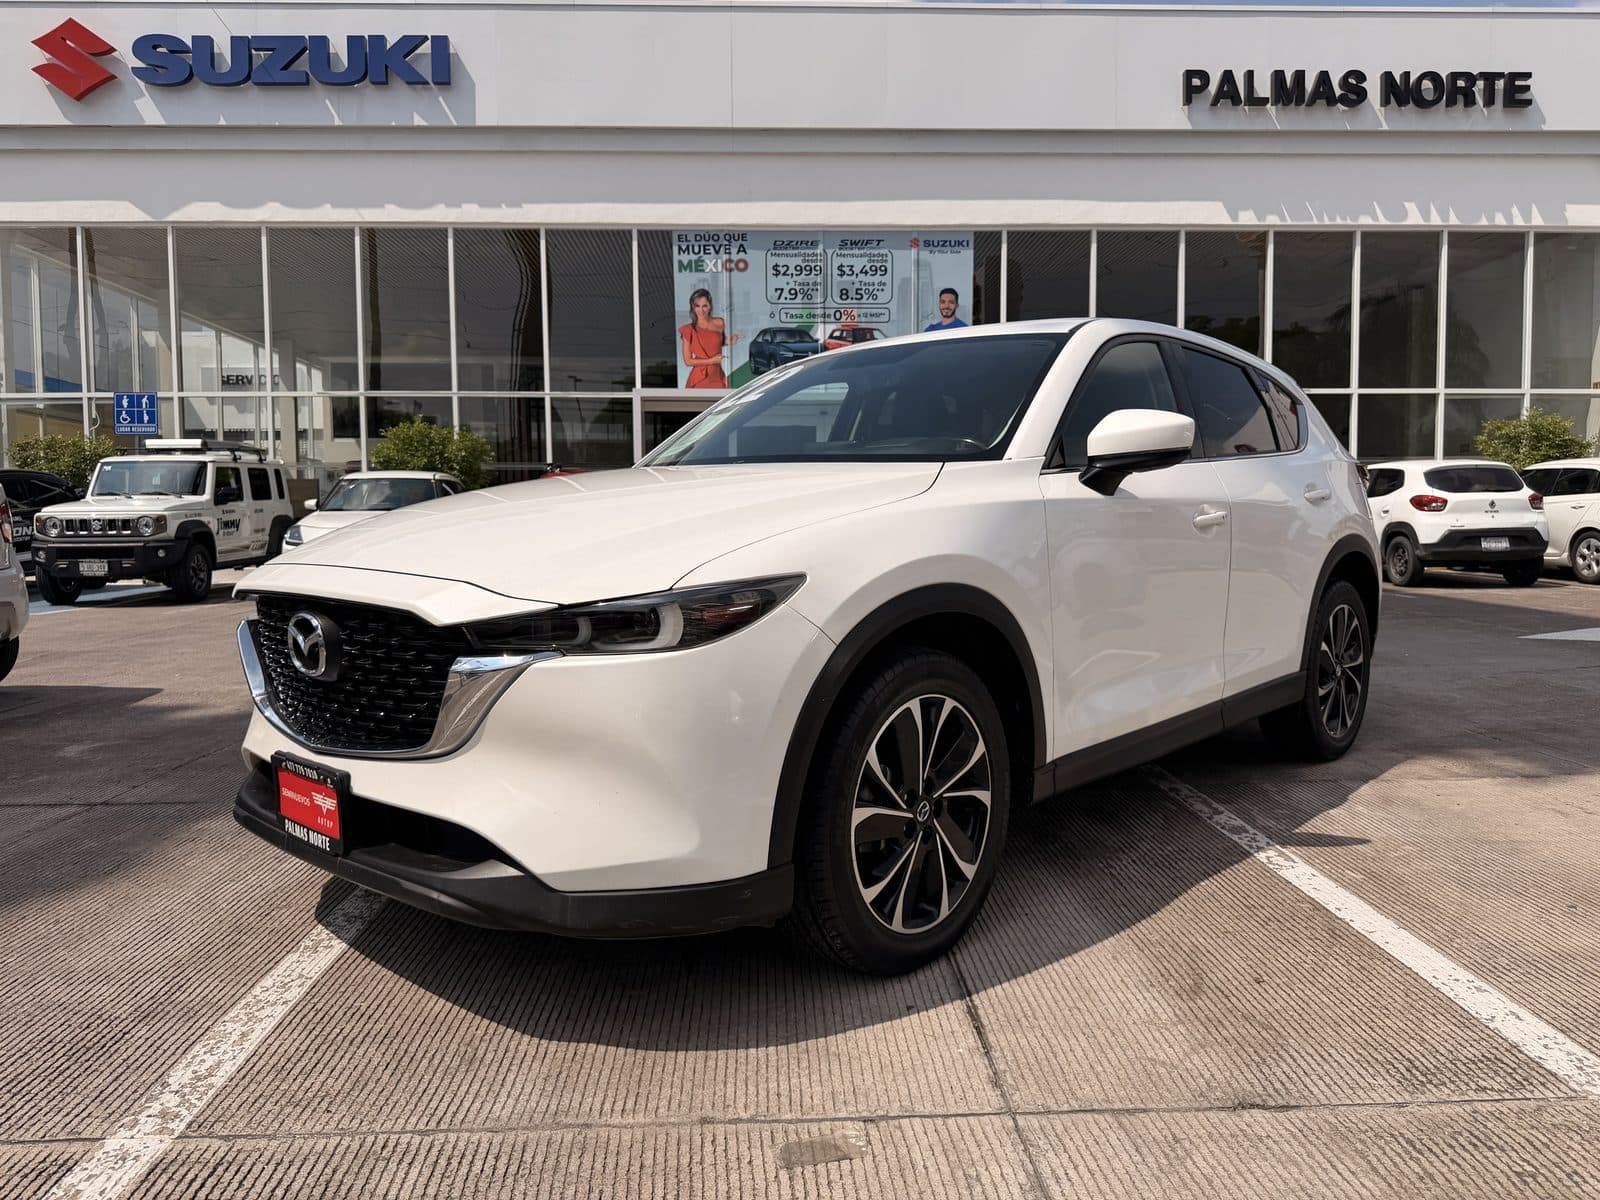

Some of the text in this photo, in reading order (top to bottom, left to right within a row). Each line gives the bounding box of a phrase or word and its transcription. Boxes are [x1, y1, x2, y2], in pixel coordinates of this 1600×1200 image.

[131, 34, 452, 87] SUZUKI
[1182, 69, 1533, 109] PALMAS NORTE
[677, 231, 748, 244] EL DÚO QUE
[773, 239, 820, 247] DZIRE
[838, 239, 886, 247] SWIFT
[923, 239, 970, 248] SUZUKI
[677, 243, 748, 256] MUEVE A
[677, 255, 749, 273] MÉXICO
[772, 262, 823, 279] $2,999
[837, 262, 889, 279] $3,499
[784, 312, 803, 320] Tasa
[805, 311, 832, 320] desde
[833, 309, 856, 321] 0%
[284, 818, 331, 851] PALMAS NORTE
